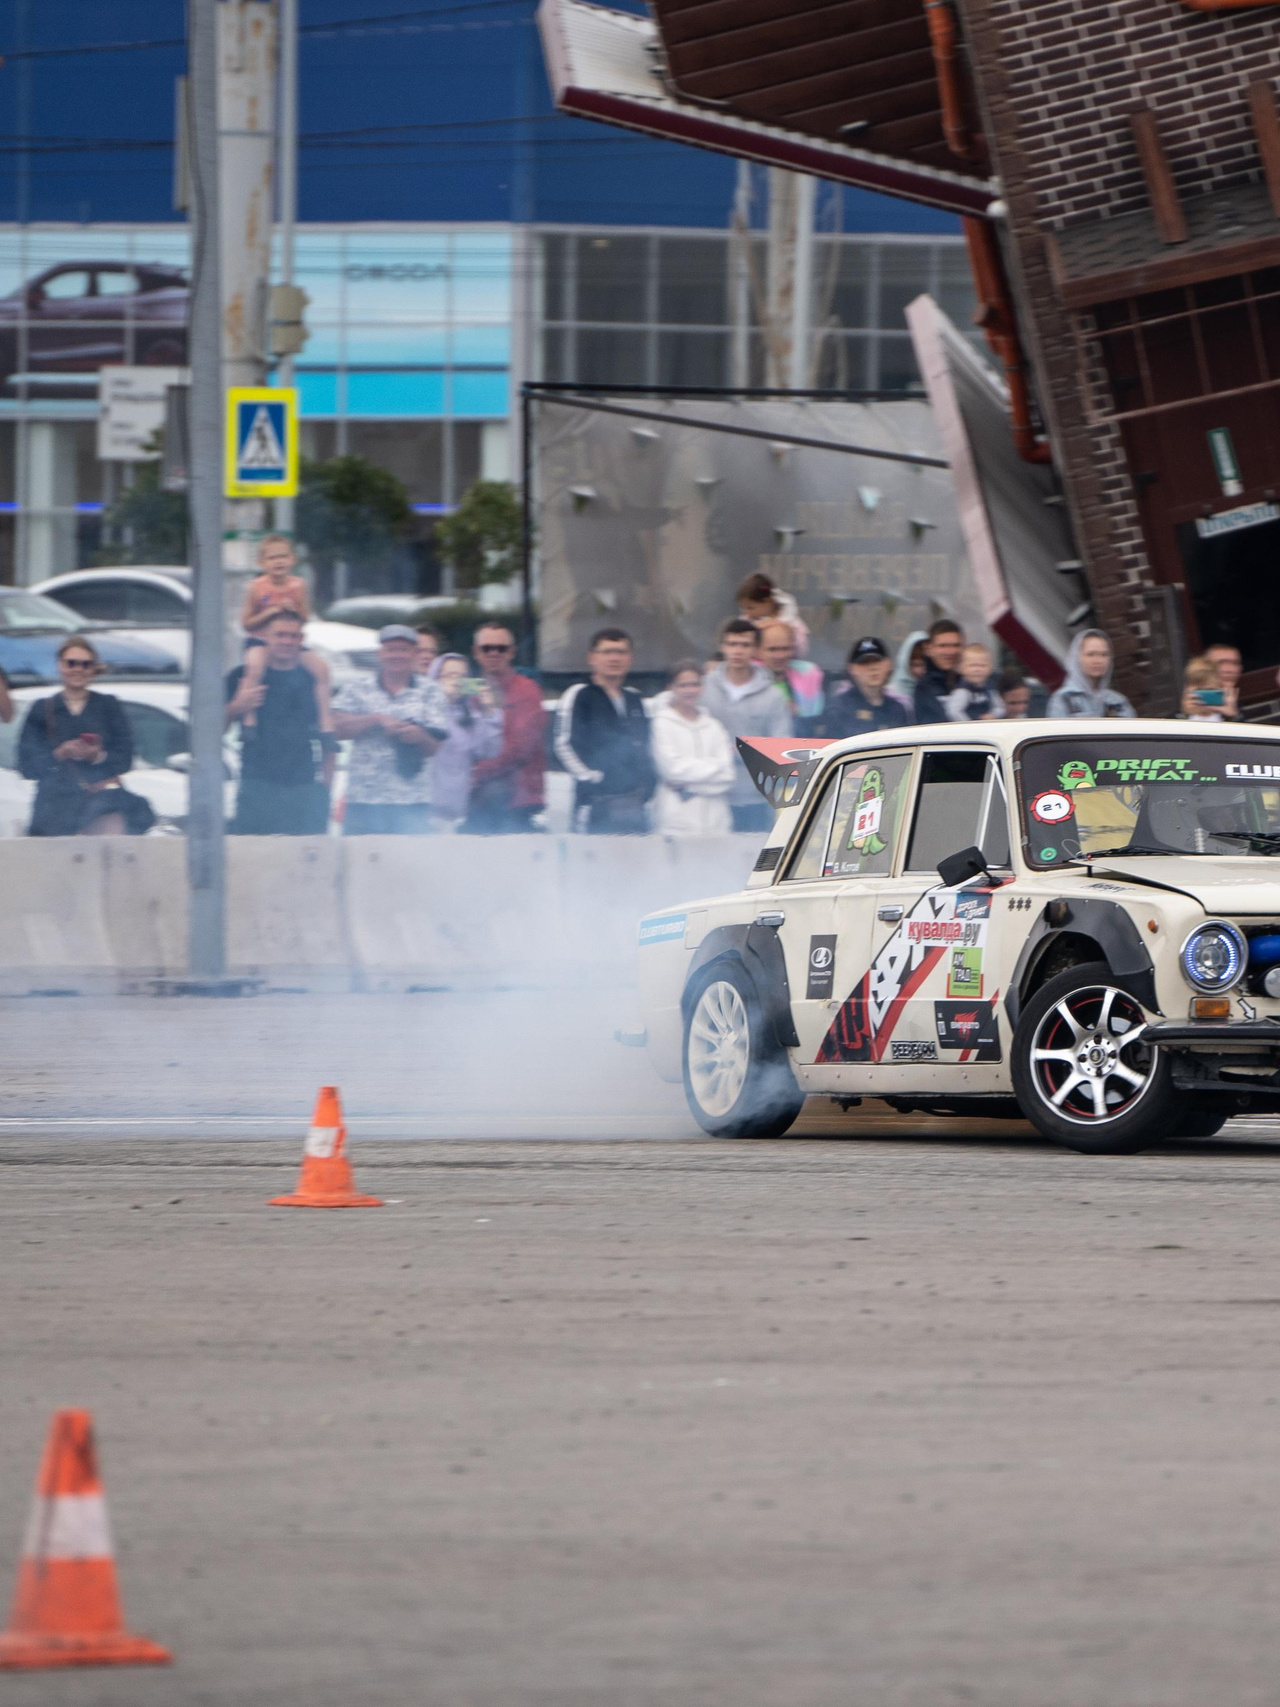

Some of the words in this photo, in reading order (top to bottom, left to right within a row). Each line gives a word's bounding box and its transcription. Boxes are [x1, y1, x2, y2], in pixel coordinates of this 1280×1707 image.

[1096, 759, 1191, 771] DRIFT
[1042, 803, 1062, 812] 21
[857, 811, 875, 831] 21
[908, 921, 981, 946] кувалда.ру
